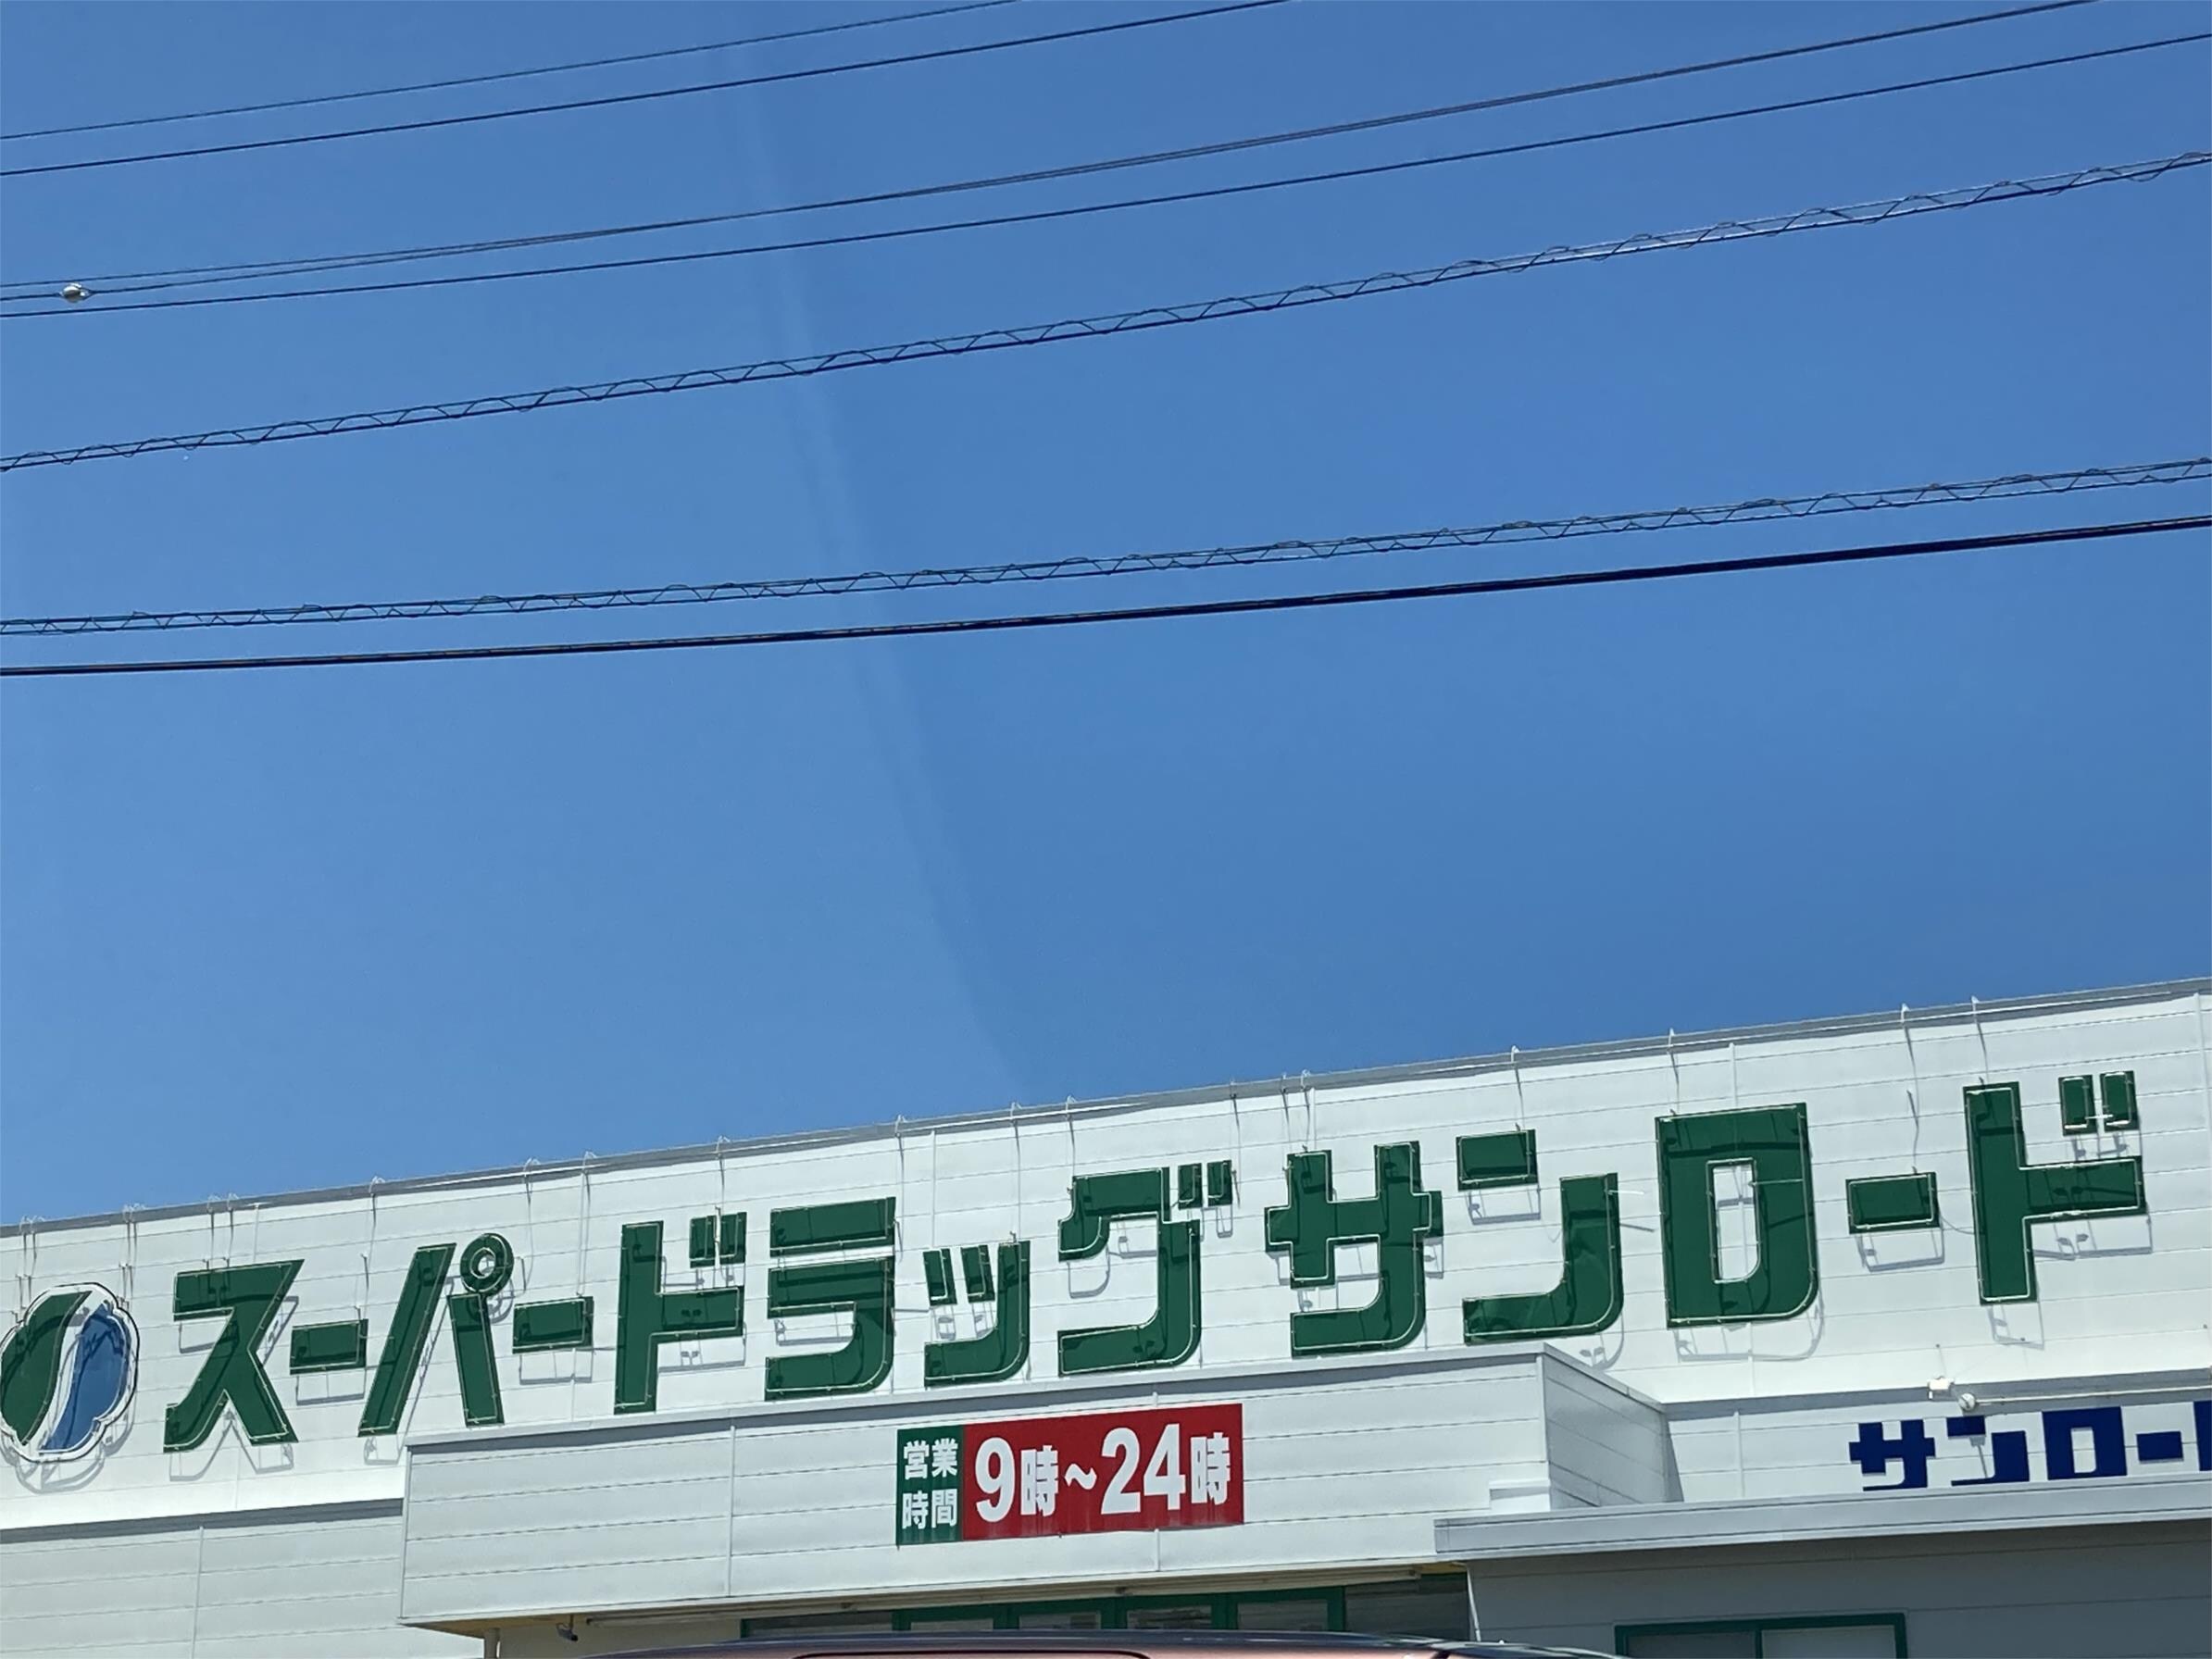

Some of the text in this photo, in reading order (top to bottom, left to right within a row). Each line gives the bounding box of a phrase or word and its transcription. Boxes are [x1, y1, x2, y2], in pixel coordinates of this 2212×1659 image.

[903, 1438, 958, 1480] 営業
[1849, 1400, 2212, 1491] サンロー
[902, 1488, 957, 1529] 時間
